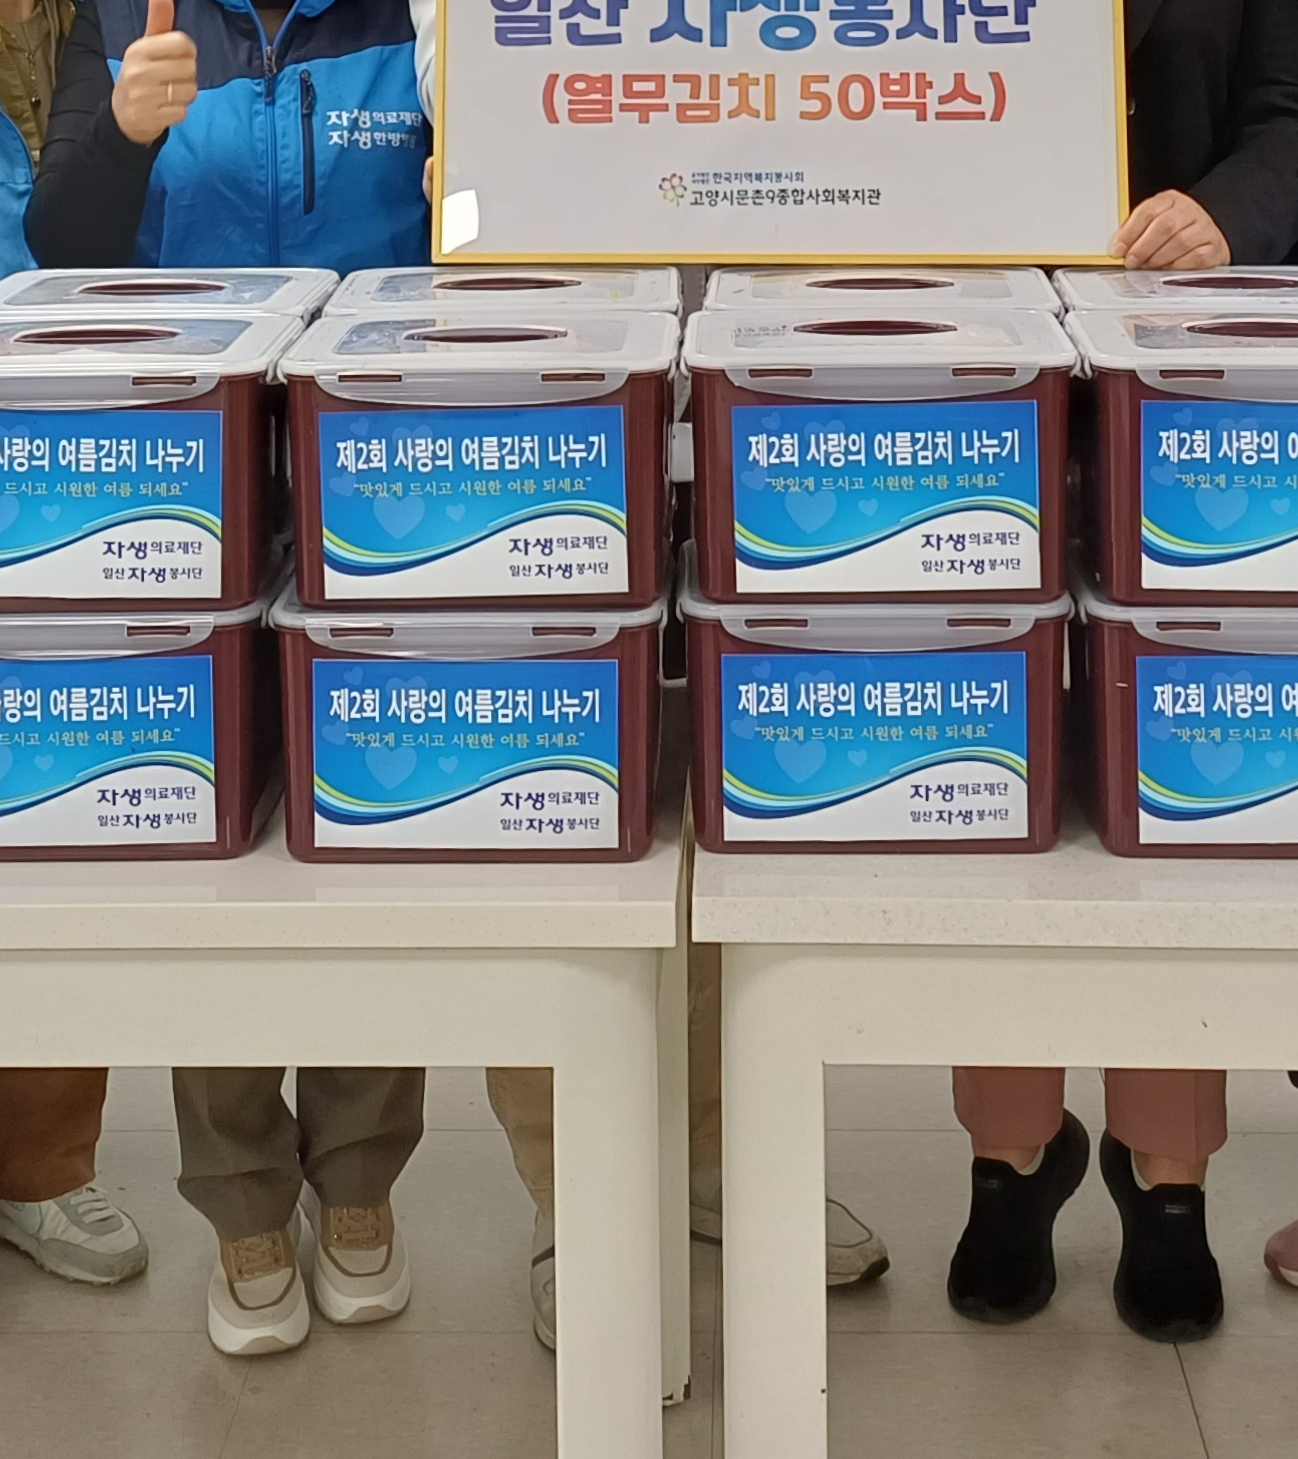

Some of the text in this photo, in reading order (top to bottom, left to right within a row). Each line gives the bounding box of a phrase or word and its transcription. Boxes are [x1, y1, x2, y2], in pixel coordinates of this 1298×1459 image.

[542, 71, 1007, 125] (열무김치 50박스)
[326, 108, 423, 128] 자생의료재단
[689, 188, 881, 208] 고양시문촌9종합사회복지관
[58, 437, 137, 473] 여름김치
[145, 438, 204, 474] 나누기
[336, 433, 607, 474] 제2회 사랑의 여름김치 나누기
[747, 429, 1020, 468] 제2회 사랑의 여름김치 나누기
[1158, 428, 1211, 464] 제2회
[1218, 428, 1279, 466] 사랑의
[408, 480, 454, 497] 드시고
[457, 479, 503, 497] 시원한
[507, 478, 537, 495] 여름
[1231, 473, 1278, 490] 드시고
[102, 540, 203, 561] 자생의료재단
[508, 535, 608, 557] 자생의료재단
[920, 531, 1021, 553] 자생의료재단
[49, 686, 129, 722] 여름김치
[136, 684, 195, 721] 나누기
[329, 687, 600, 725] 제2회 사랑의 여름김치 나누기
[737, 680, 1009, 718] 제2회 사랑의 여름김치 나누기
[1152, 682, 1205, 719] 제2회
[1212, 681, 1274, 719] 사랑의
[96, 786, 197, 808] 자생의료재단
[500, 791, 600, 812] 자생의료재단
[909, 782, 1009, 804] 자생의료재단
